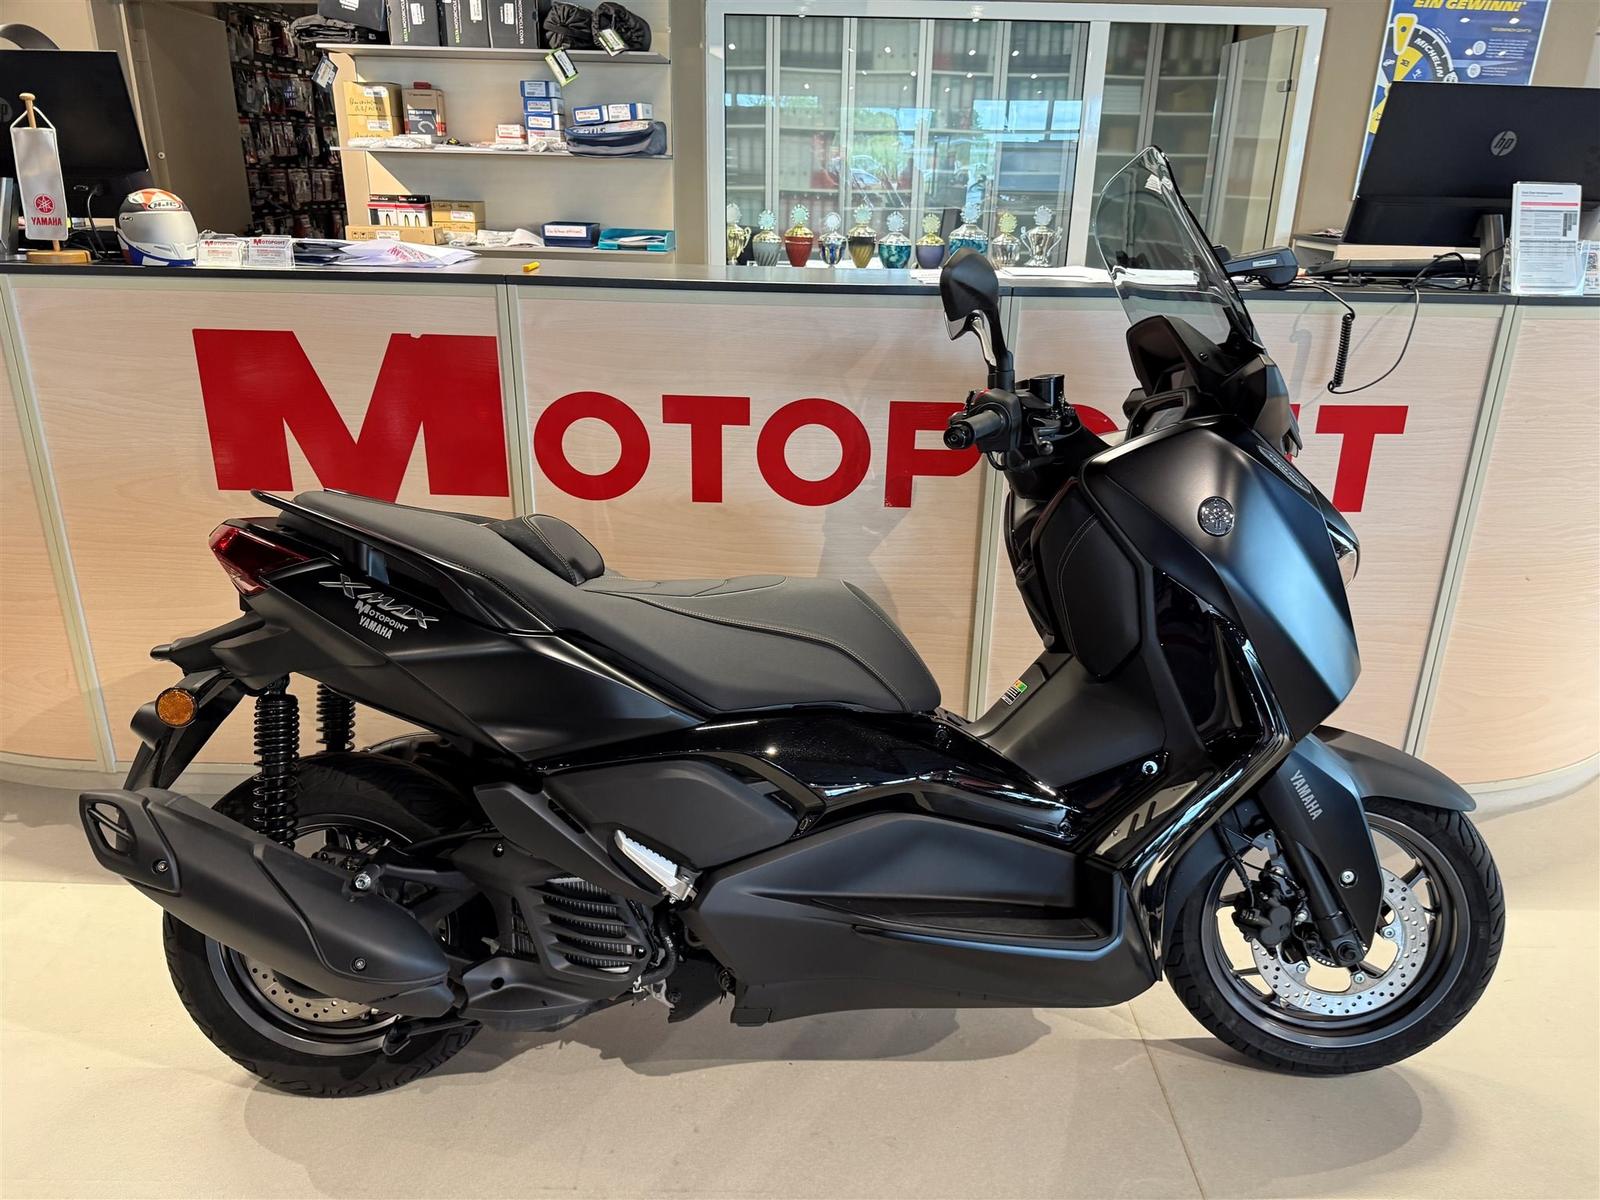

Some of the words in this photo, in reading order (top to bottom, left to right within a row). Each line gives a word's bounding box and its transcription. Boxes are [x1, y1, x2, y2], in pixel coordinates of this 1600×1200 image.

[1412, 0, 1442, 8] EIN
[1414, 37, 1445, 78] MICHELIN
[31, 216, 62, 226] YAMAHA
[253, 238, 286, 246] MOTOPOINT
[193, 328, 1409, 513] MOTOPT
[354, 599, 409, 632] MOTOPOINT
[359, 615, 393, 640] YAMAHA
[1290, 769, 1323, 821] YAMAHA
